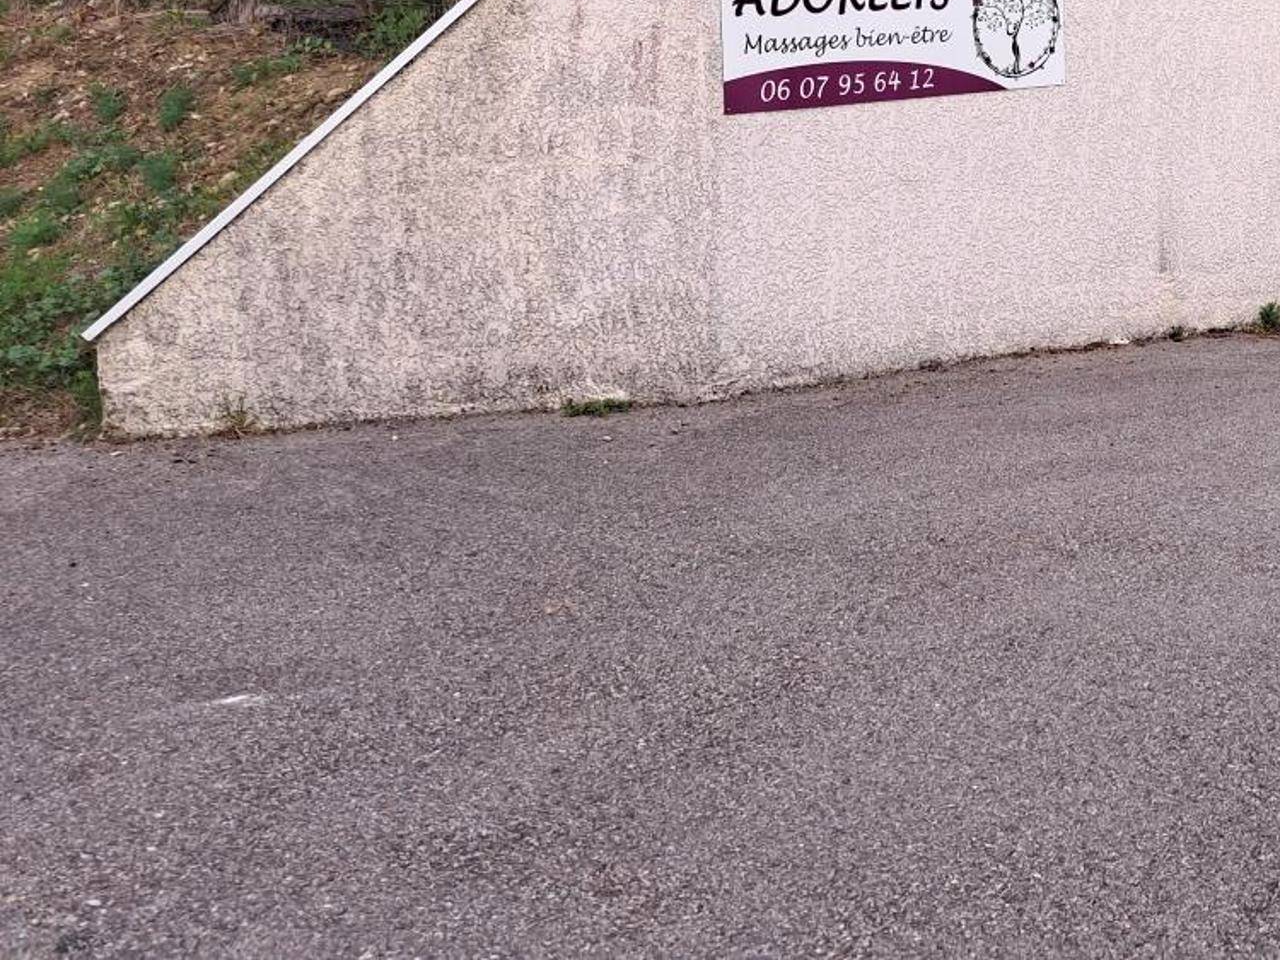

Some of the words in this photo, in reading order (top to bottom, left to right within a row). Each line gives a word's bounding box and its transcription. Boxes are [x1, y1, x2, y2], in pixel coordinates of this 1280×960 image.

[744, 33, 852, 57] Massages
[856, 26, 953, 48] bien-être
[760, 79, 791, 102] 06
[800, 76, 829, 98] 07
[838, 73, 865, 96] 95
[874, 70, 901, 92] 64
[909, 68, 935, 90] 12
